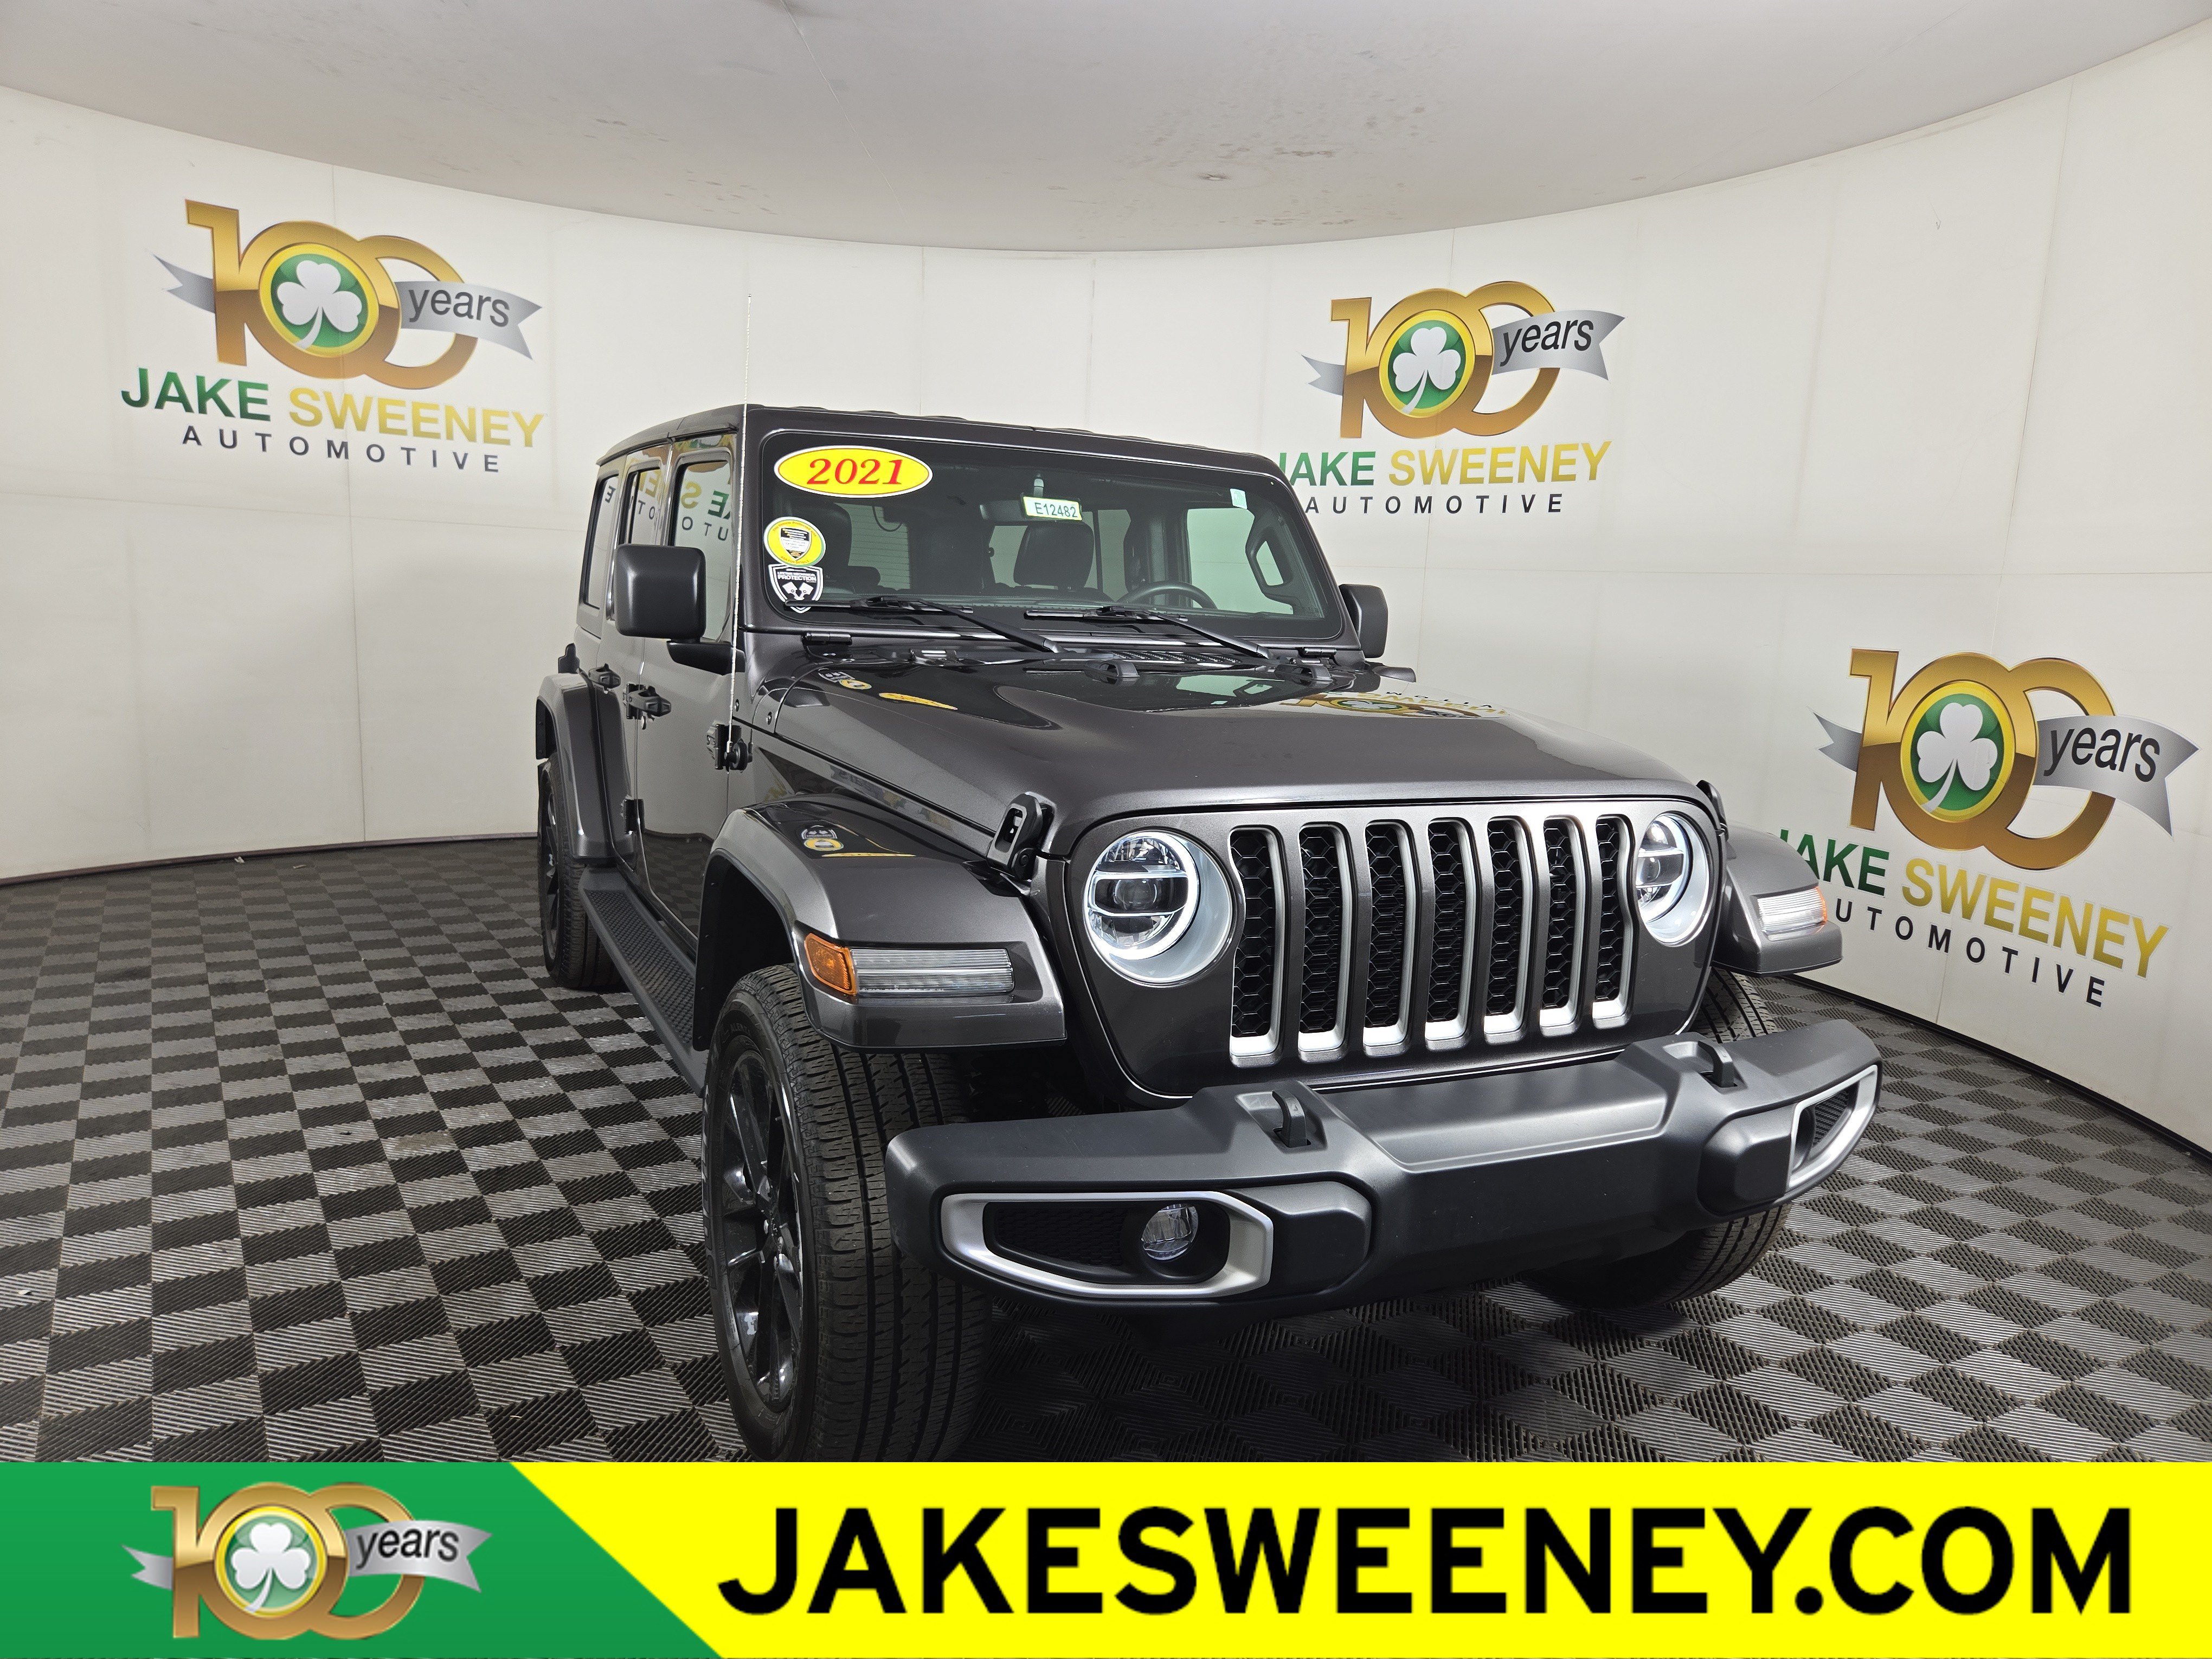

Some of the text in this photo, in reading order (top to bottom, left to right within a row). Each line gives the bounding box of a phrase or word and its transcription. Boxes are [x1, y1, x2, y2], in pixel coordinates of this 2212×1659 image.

[408, 289, 510, 327] years
[1500, 318, 1594, 367] years
[121, 367, 544, 448] JAKE SWEENEY
[182, 425, 499, 473] AUTOMOTIVE
[806, 458, 902, 485] 2021
[1388, 441, 1611, 486] SWEENEY
[1034, 502, 1078, 518] E12482
[1304, 493, 1562, 515] AUTOMOTIVE
[2043, 726, 2160, 782] years
[1780, 828, 2169, 978] AKE SWEENEY
[1835, 898, 2105, 1007] UTOMOTIVE
